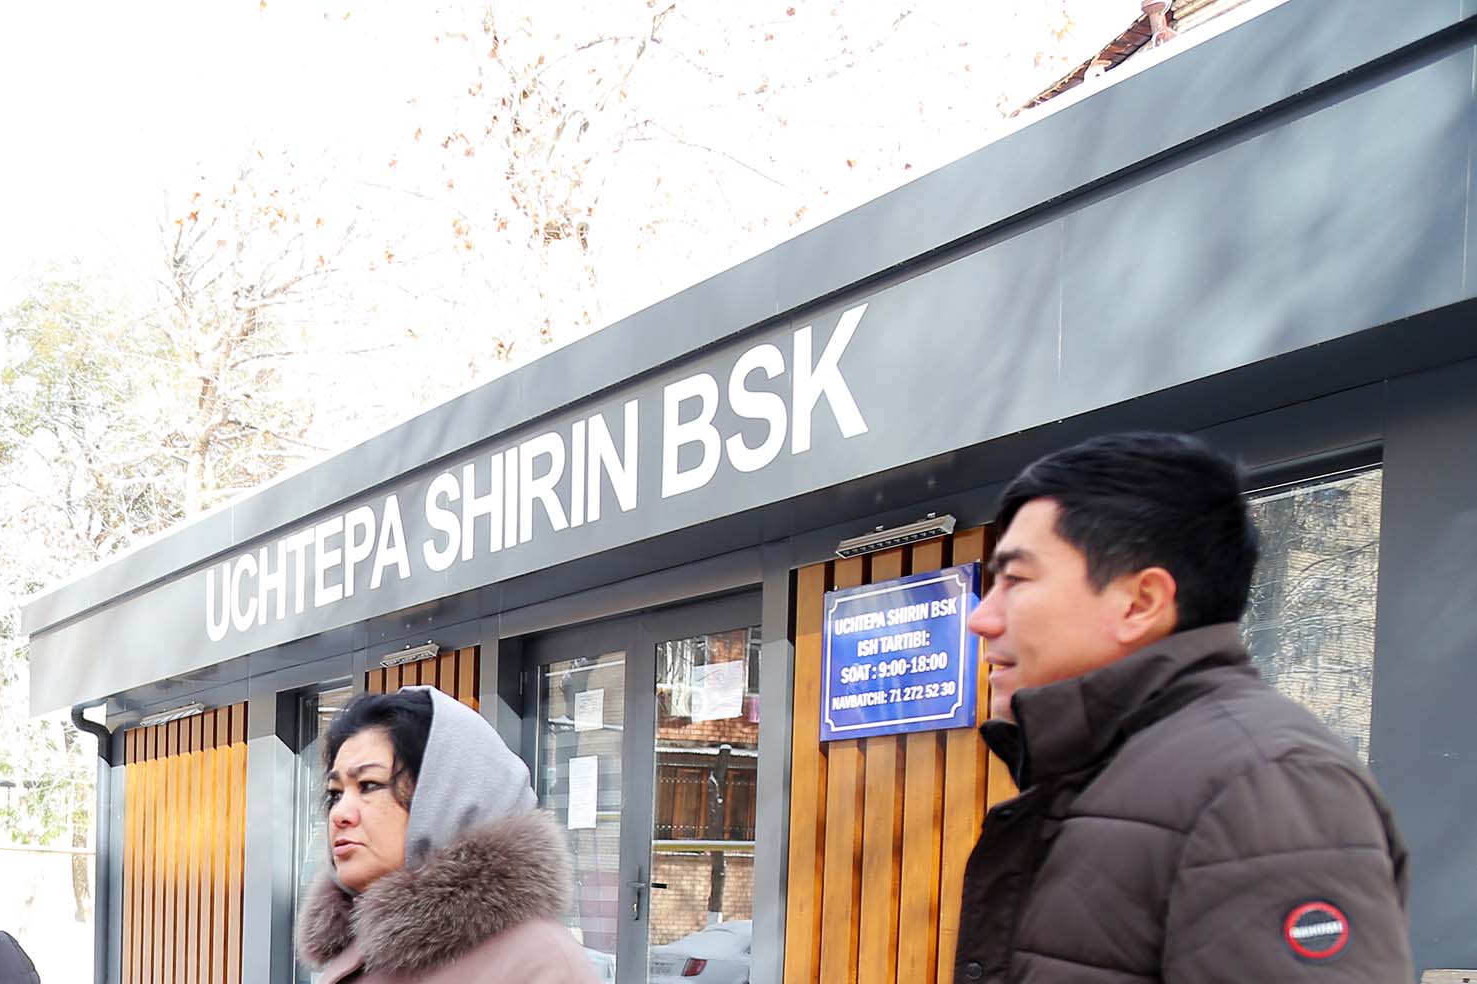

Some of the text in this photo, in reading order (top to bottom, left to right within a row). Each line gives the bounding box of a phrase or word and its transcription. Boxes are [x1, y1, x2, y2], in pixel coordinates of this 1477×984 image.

[205, 302, 869, 642] UCHTEPA SHIRIN BSK
[835, 598, 957, 634] UCHTEPA SHIRIN BSK
[858, 630, 930, 657] ISH TARTIBI:
[878, 652, 948, 678] 9:00-18:00
[889, 688, 901, 703] 71
[903, 685, 924, 701] 272
[925, 683, 940, 698] 52
[940, 680, 956, 696] 30
